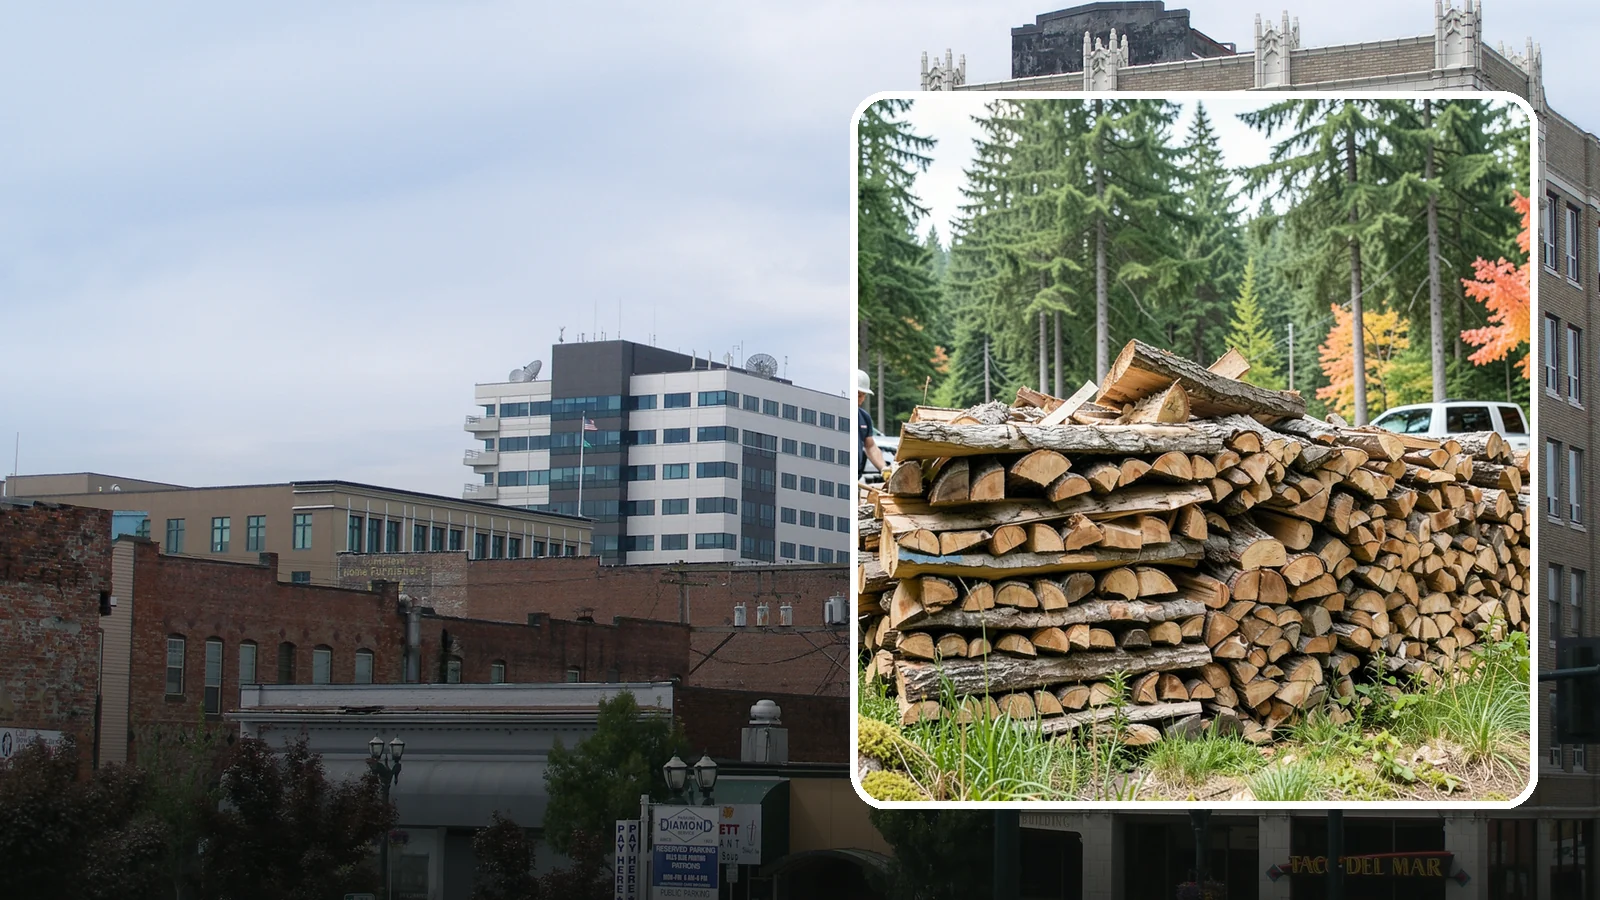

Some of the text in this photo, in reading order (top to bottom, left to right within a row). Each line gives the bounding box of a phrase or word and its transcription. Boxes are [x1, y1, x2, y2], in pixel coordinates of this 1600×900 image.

[343, 566, 427, 577] Home Furnishers
[660, 818, 713, 833] DIAMOND
[1021, 815, 1070, 828] BUILDING
[656, 845, 716, 854] RESERVED PARKING
[616, 825, 625, 893] PAY HERE
[627, 824, 637, 893] PAY HERE
[721, 851, 739, 862] Soup
[1290, 855, 1442, 877] TAC DEL MAR
[660, 888, 710, 898] PUBLIC PARKING
